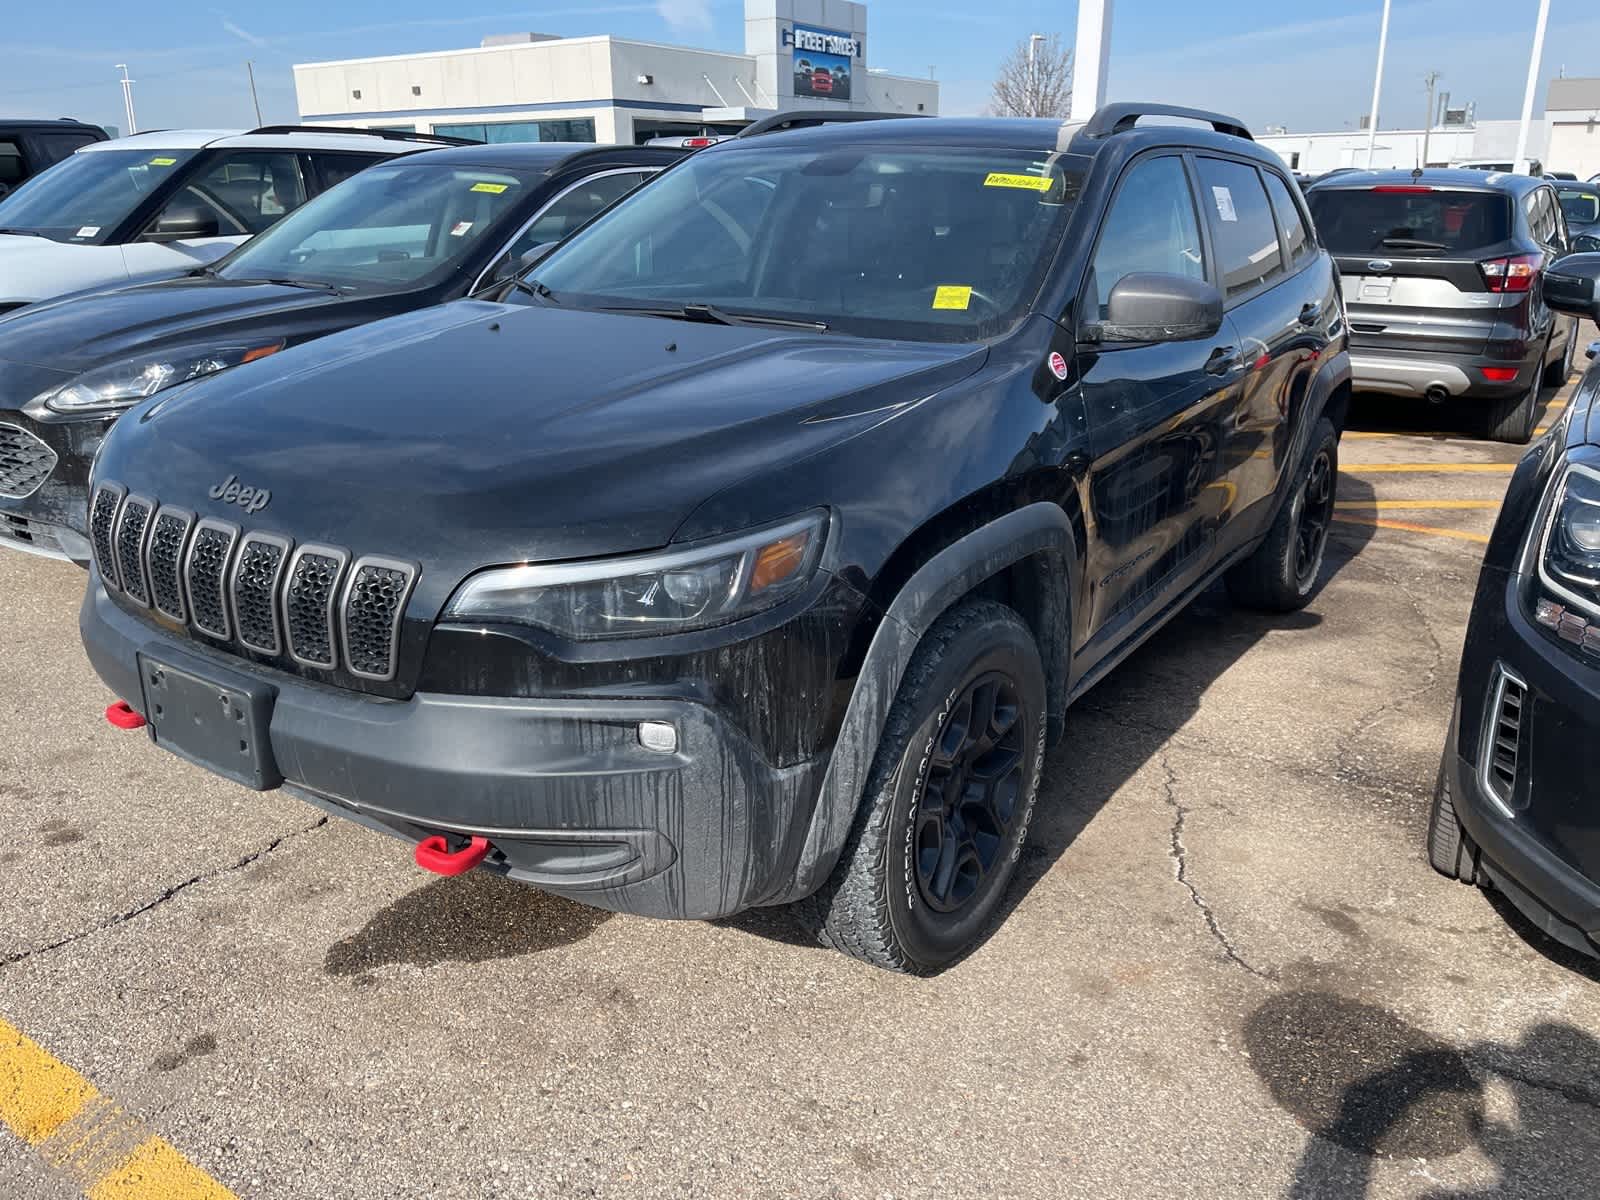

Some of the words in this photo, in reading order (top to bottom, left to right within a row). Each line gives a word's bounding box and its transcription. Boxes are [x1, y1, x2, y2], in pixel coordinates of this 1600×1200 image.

[796, 30, 826, 52] FLEET
[828, 35, 857, 56] SALES
[209, 473, 272, 514] Jeep
